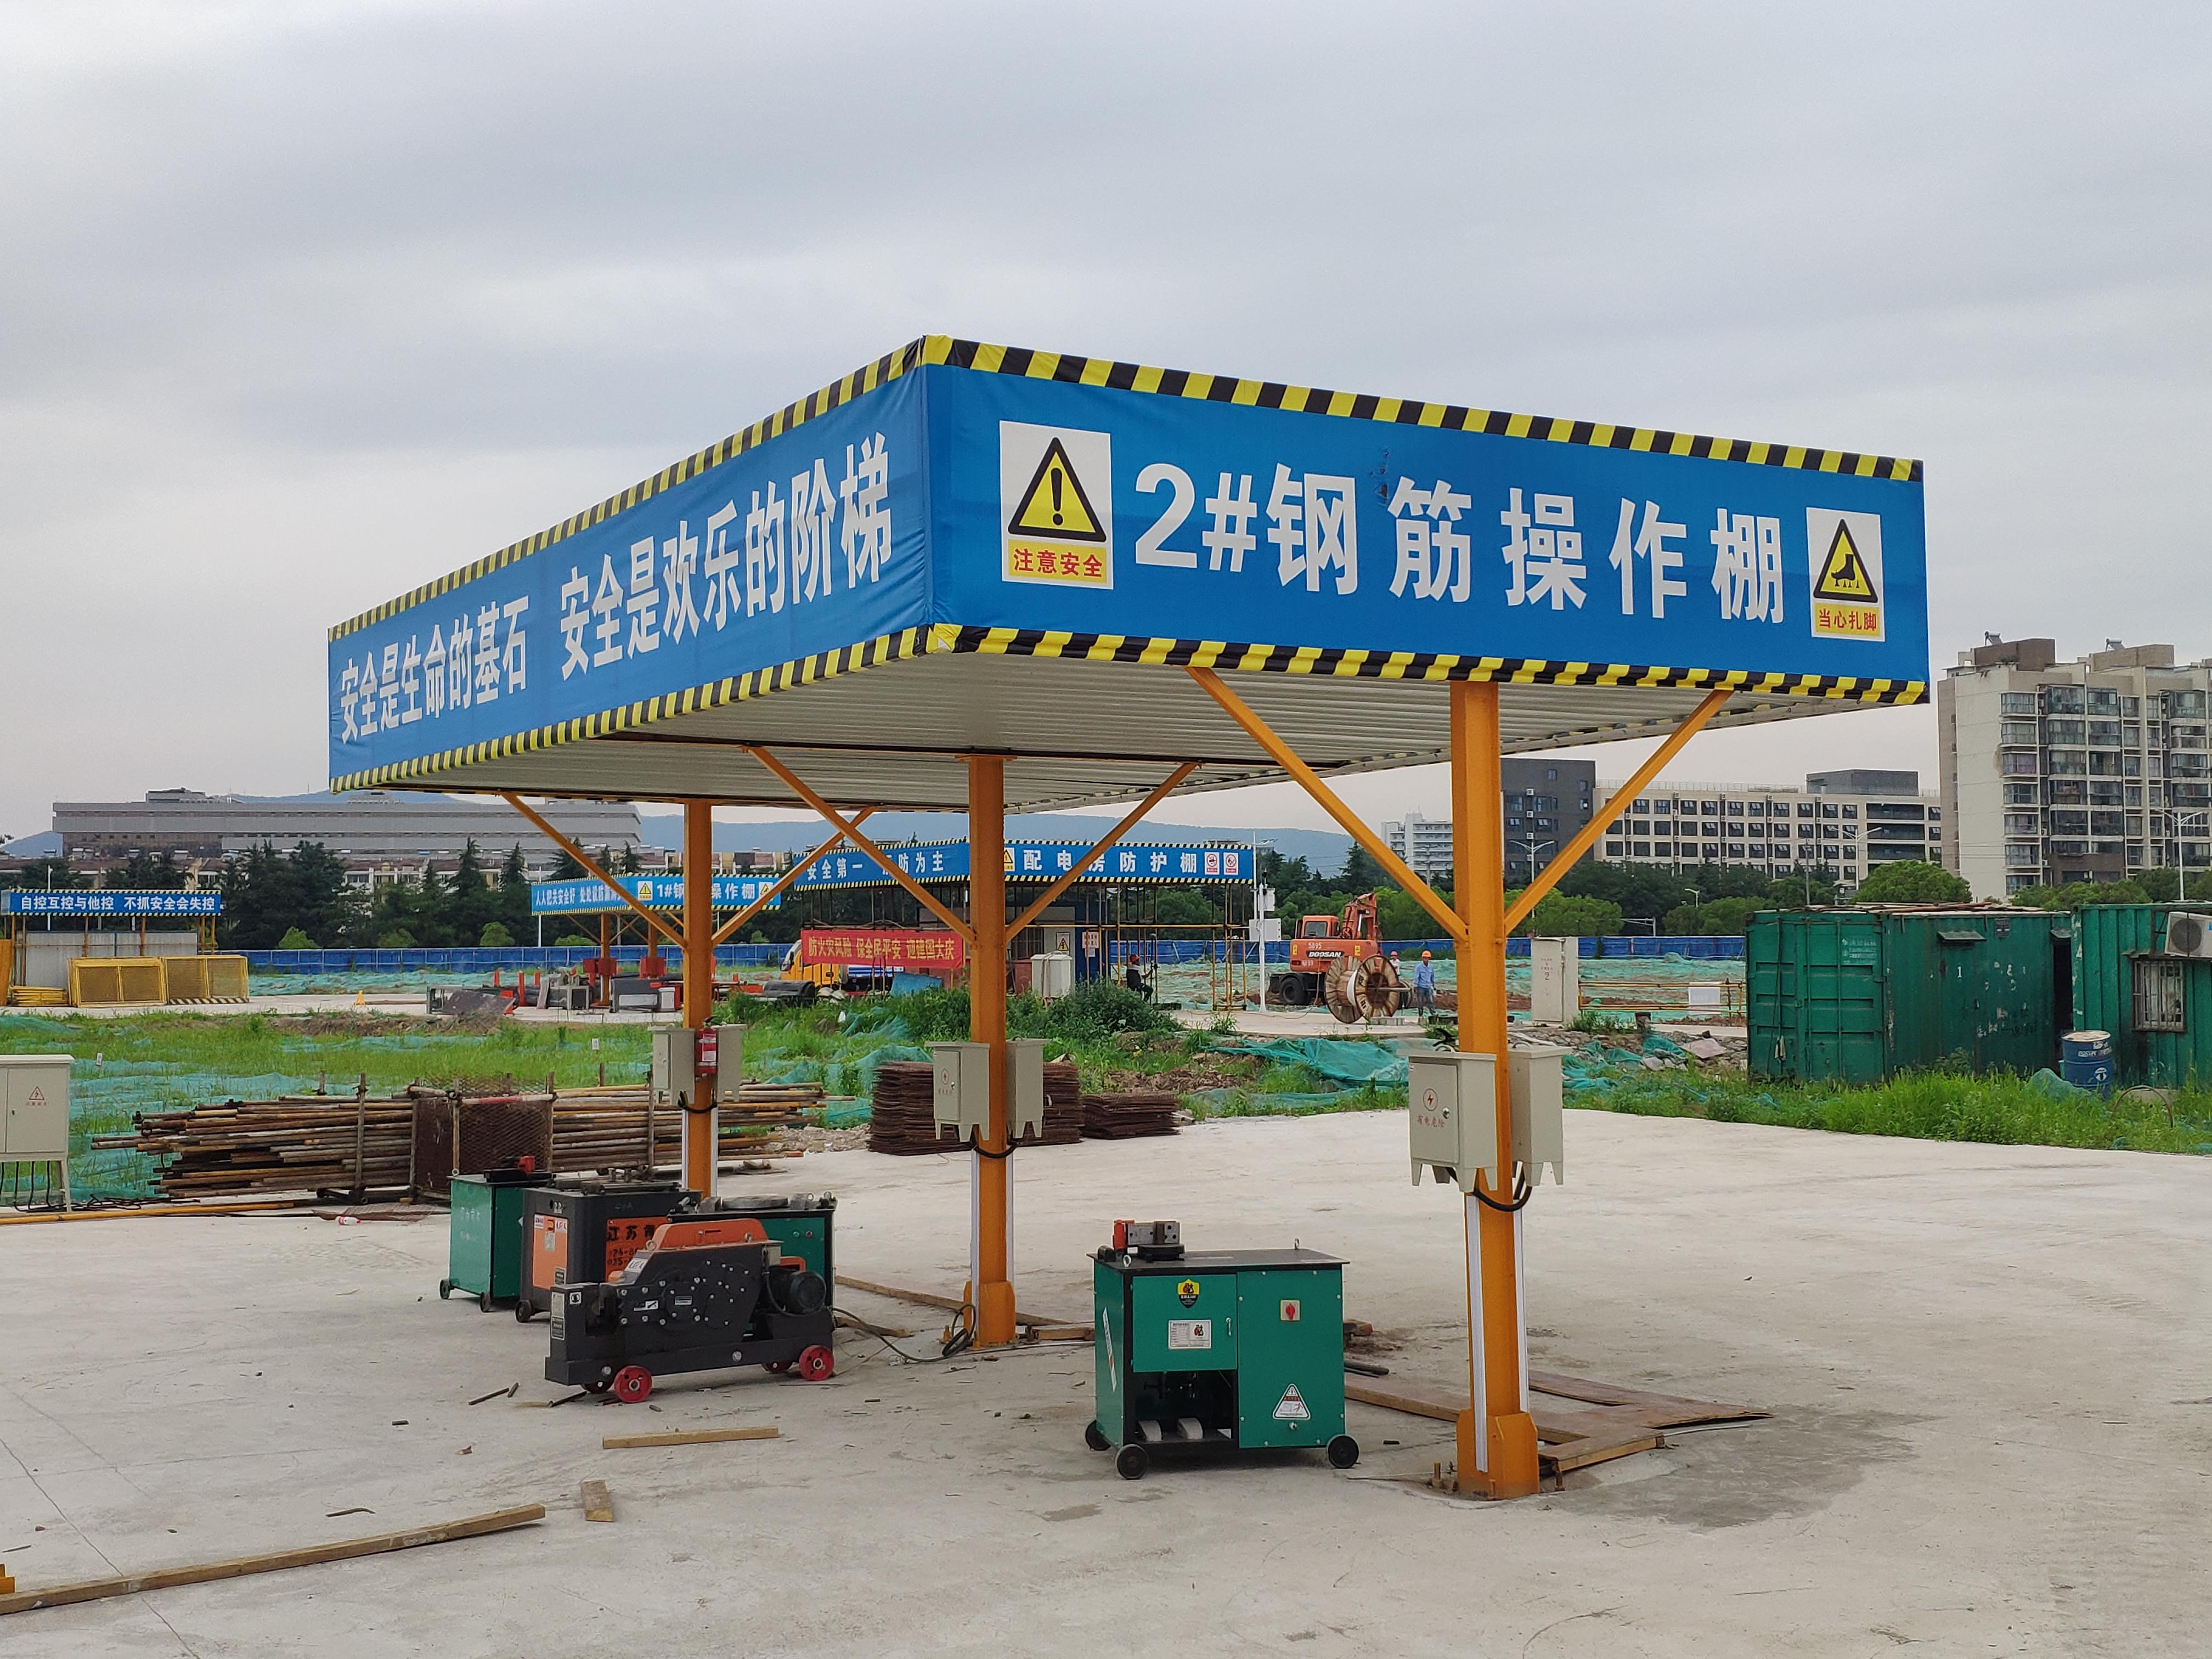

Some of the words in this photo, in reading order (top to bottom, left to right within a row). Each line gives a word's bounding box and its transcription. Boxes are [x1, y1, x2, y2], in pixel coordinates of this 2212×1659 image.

[1013, 548, 1103, 578] 注意安全
[341, 595, 529, 744] 安全是生命的基石
[561, 432, 892, 681] 安全是欢乐的阶梯
[1819, 608, 1877, 631] 当心扎脚
[806, 857, 863, 881] 安全第一
[21, 896, 114, 911] 自控互控与他控
[124, 896, 215, 911] 不抓安全会失控
